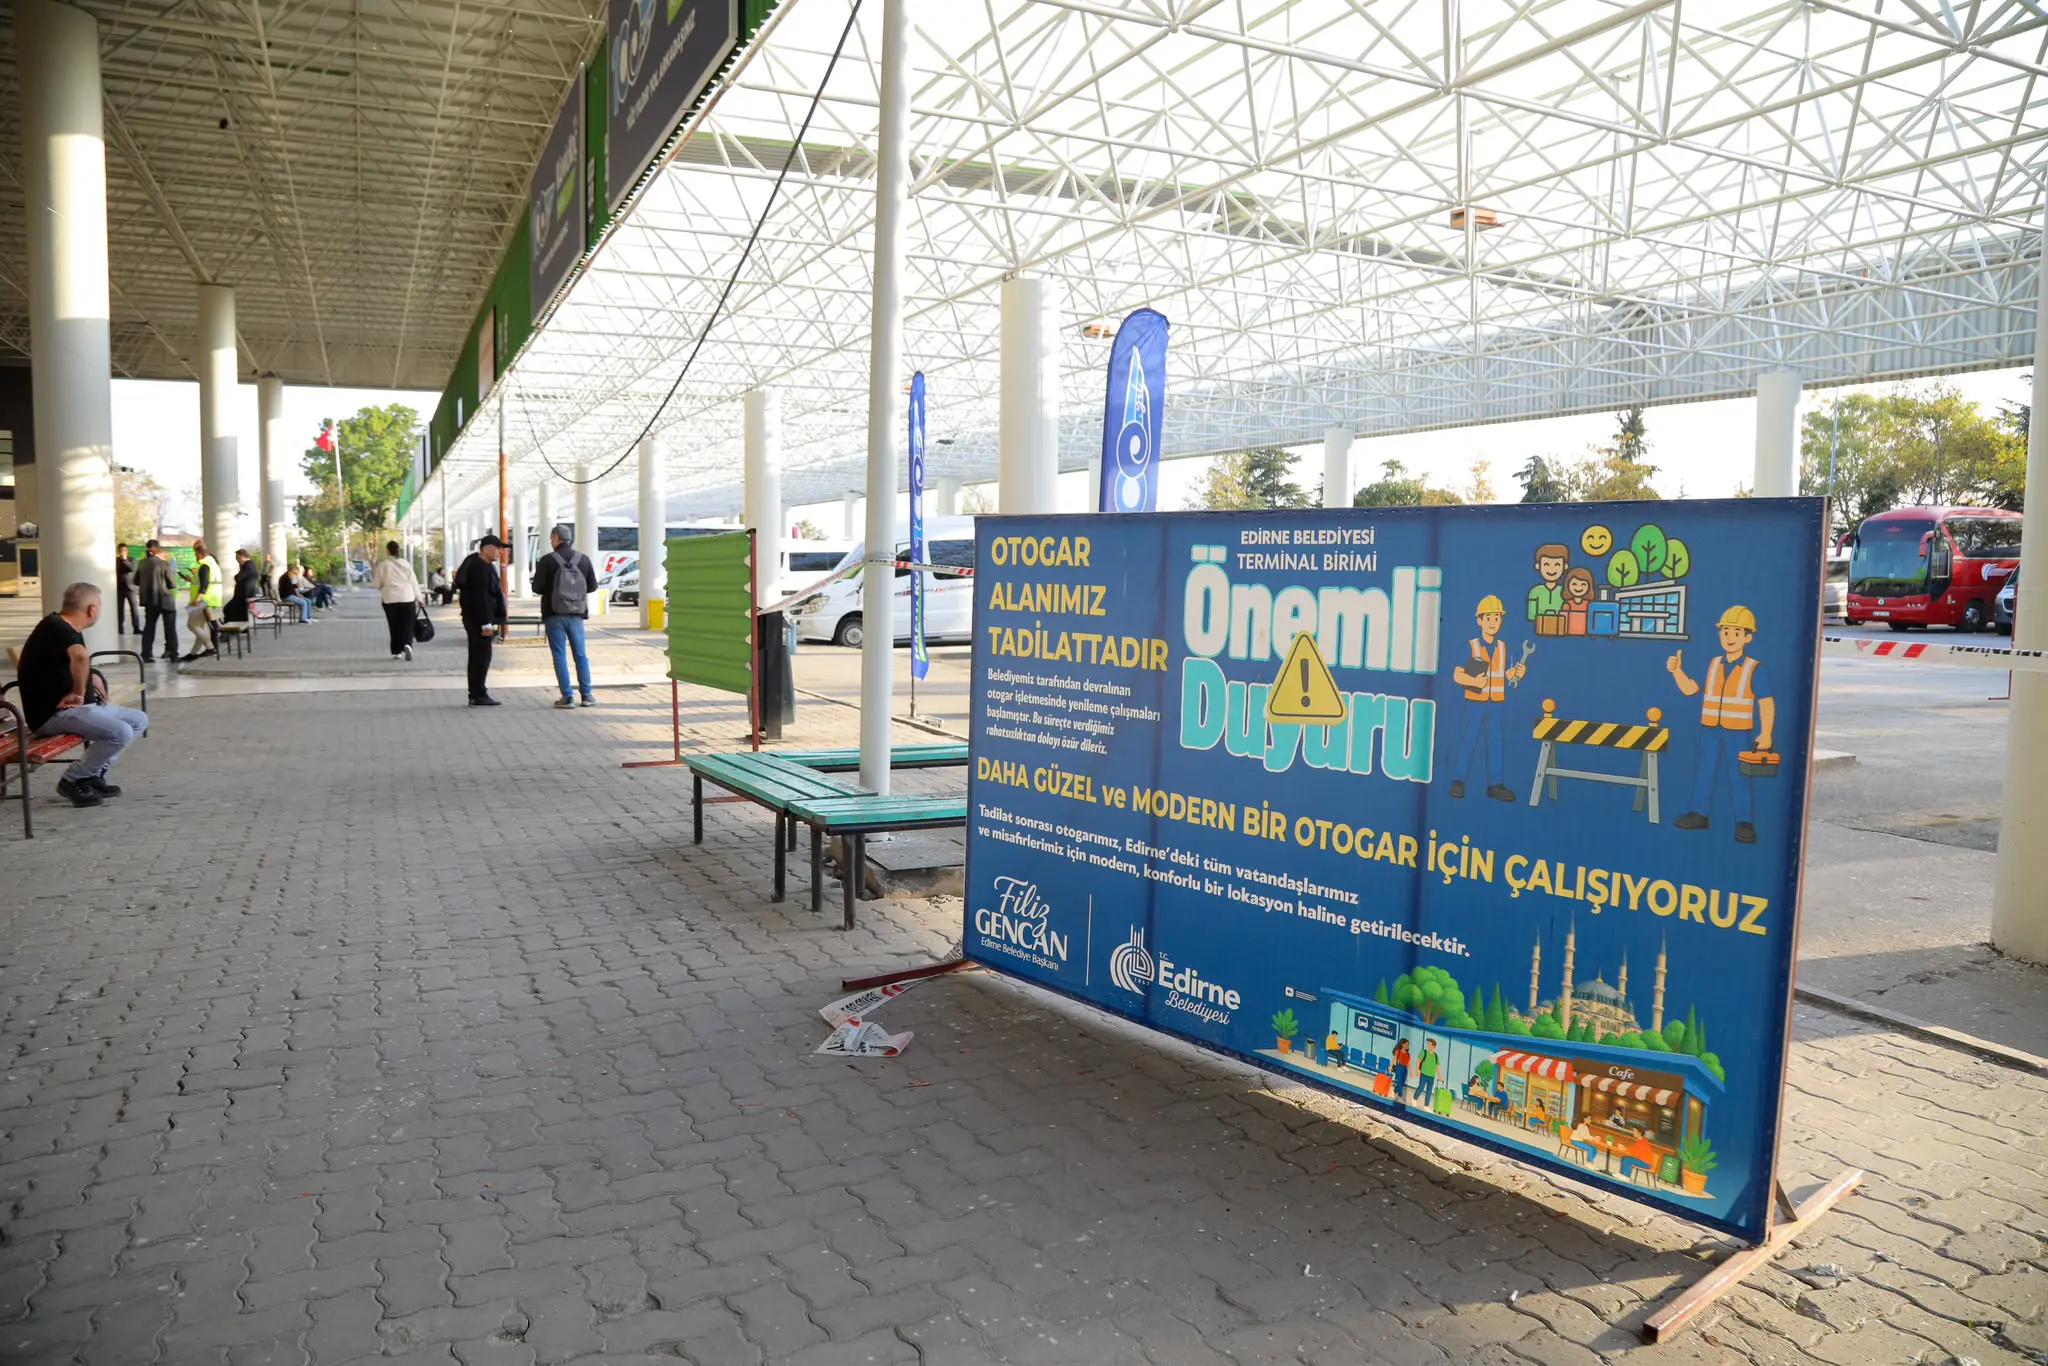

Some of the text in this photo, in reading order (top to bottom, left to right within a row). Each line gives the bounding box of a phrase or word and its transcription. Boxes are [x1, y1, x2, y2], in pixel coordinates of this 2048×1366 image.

[991, 536, 1091, 566] OTOGAR
[1240, 526, 1375, 545] EDİRNE BELEDİYESİ
[1237, 550, 1378, 572] TERMİNAL BİRİMİ
[989, 582, 1106, 616] ALANIMIZ
[1183, 544, 1442, 674] Önemli
[988, 620, 1168, 671] TADİLATTADIR
[988, 668, 1131, 696] Belediyemiz tarafından devralınan
[986, 705, 1114, 736] başlamıştır. Bu süreçte verdiğimiz
[987, 690, 1160, 722] otogar işletmesinde yenileme çalışmaları
[1180, 656, 1436, 784] Duyuru
[986, 725, 1108, 754] rahatsızlıktan dolayı özür dileriz.
[977, 756, 1769, 936] DAHA GÜZEL ve MODERN BİR OTOGAR İÇİN ÇALIŞIYORUZ
[979, 804, 1359, 904] Tadilat sonrası otogarımız, Edirne'deki tüm vatandaşlarımız
[978, 826, 1471, 957] ve misafirlerimiz için modern, konforlu bir lokasyon haline getirilecektir.
[994, 875, 1050, 938] Filiz
[975, 909, 1068, 961] GENCAN
[981, 936, 1058, 971] Edirne Belediye Başkanı
[1159, 960, 1241, 1010] Edirne
[1165, 991, 1230, 1025] Belediyesi
[1609, 1066, 1634, 1080] Cafe
